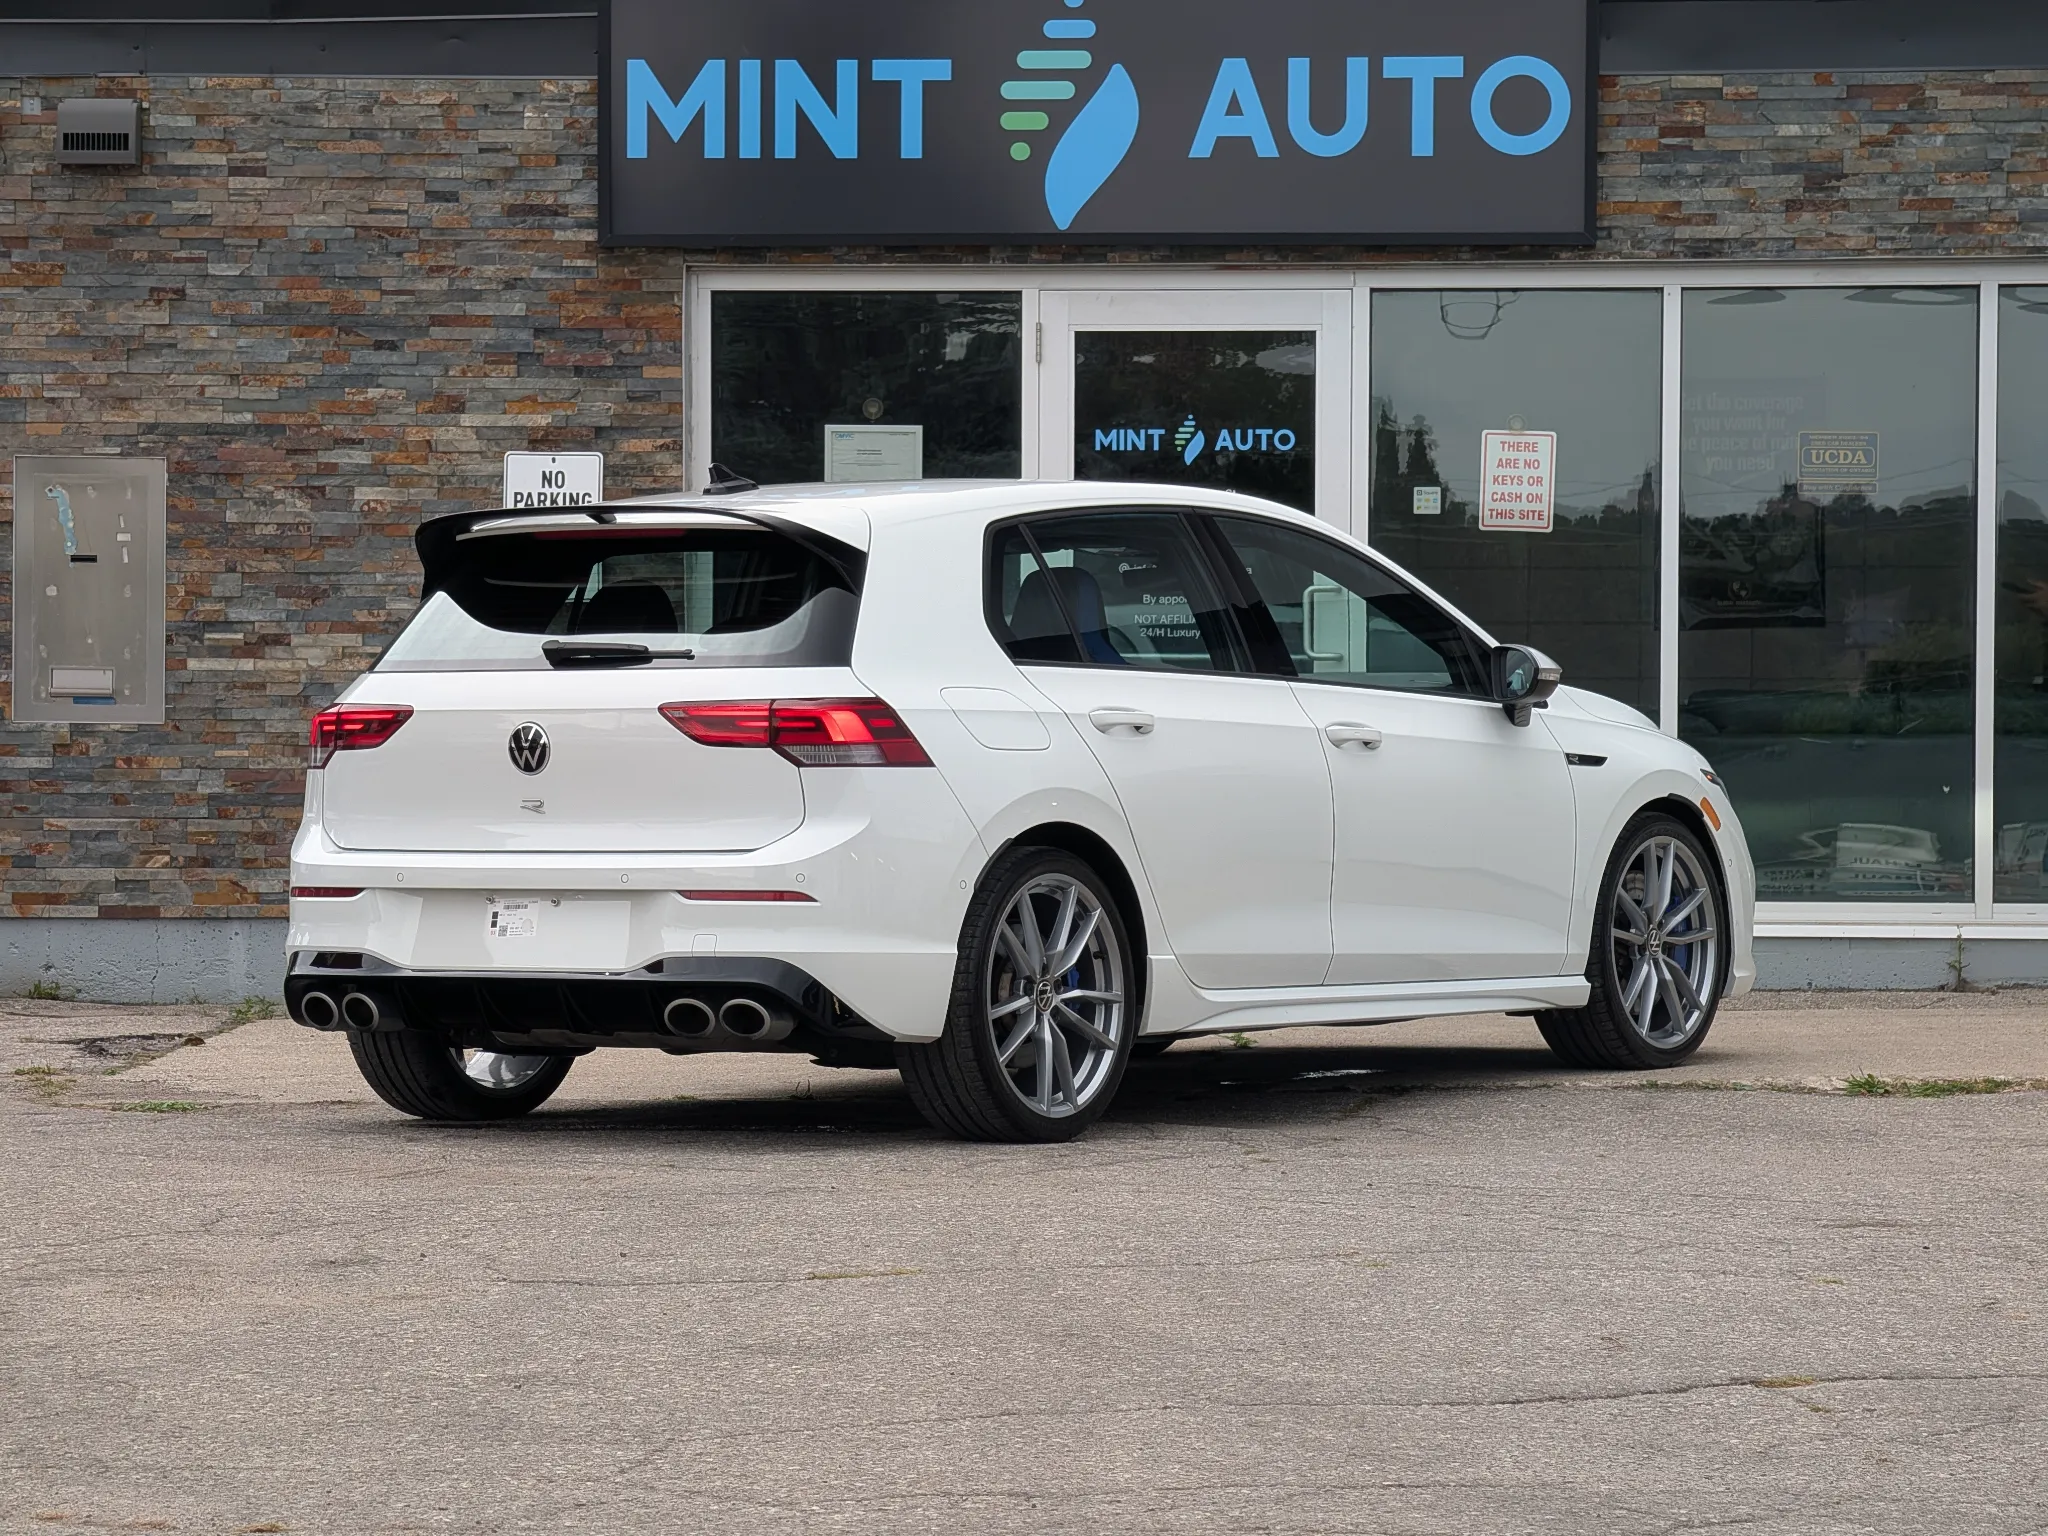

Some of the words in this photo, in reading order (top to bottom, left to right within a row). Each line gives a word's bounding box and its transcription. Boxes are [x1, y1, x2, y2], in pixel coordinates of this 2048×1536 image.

[626, 58, 953, 160] MINT
[1187, 55, 1572, 158] AUTO
[1094, 429, 1166, 451] MINT
[1214, 429, 1296, 451] AUTO
[1500, 441, 1539, 453] THERE
[1810, 449, 1867, 464] UCDA
[1496, 458, 1520, 470] ARE
[1523, 458, 1540, 470] NO
[541, 470, 566, 489] NO
[1492, 475, 1524, 487] KEYS
[1527, 475, 1544, 487] OR
[514, 491, 593, 508] PARKING
[1491, 491, 1522, 503] CASH
[1526, 492, 1543, 504] ON
[1488, 508, 1515, 520] THIS
[1518, 509, 1545, 521] SITE
[1143, 594, 1156, 606] By
[1159, 596, 1187, 606] appo
[1134, 614, 1157, 624] NOT
[1140, 628, 1164, 638] 24/H
[1167, 628, 1200, 640] Luxury
